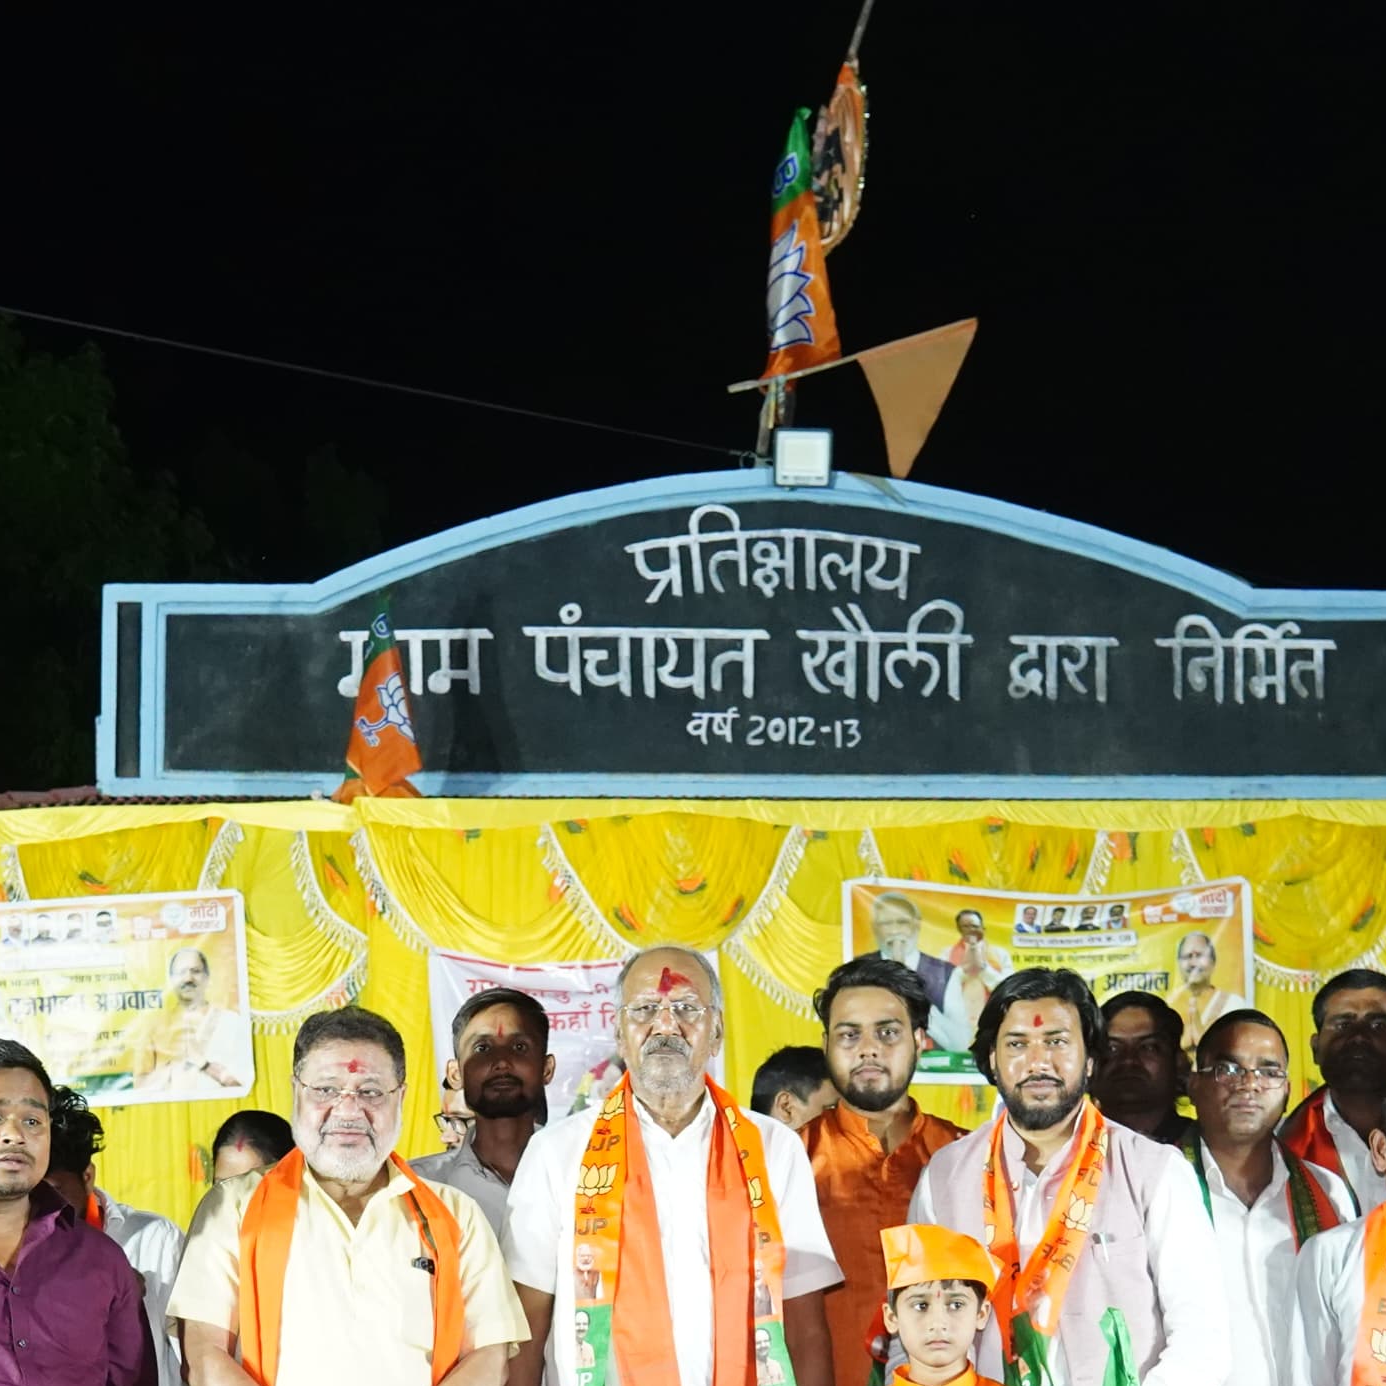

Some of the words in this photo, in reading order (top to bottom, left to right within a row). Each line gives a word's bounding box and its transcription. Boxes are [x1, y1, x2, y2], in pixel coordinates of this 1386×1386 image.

[522, 603, 771, 699] पंचायत
[796, 600, 973, 702] खौली
[1009, 635, 1118, 702] द्वारा
[1155, 614, 1336, 704] निर्मित
[687, 707, 739, 745] वर्ष
[746, 714, 861, 748] 2012-13
[586, 1135, 619, 1152] JP
